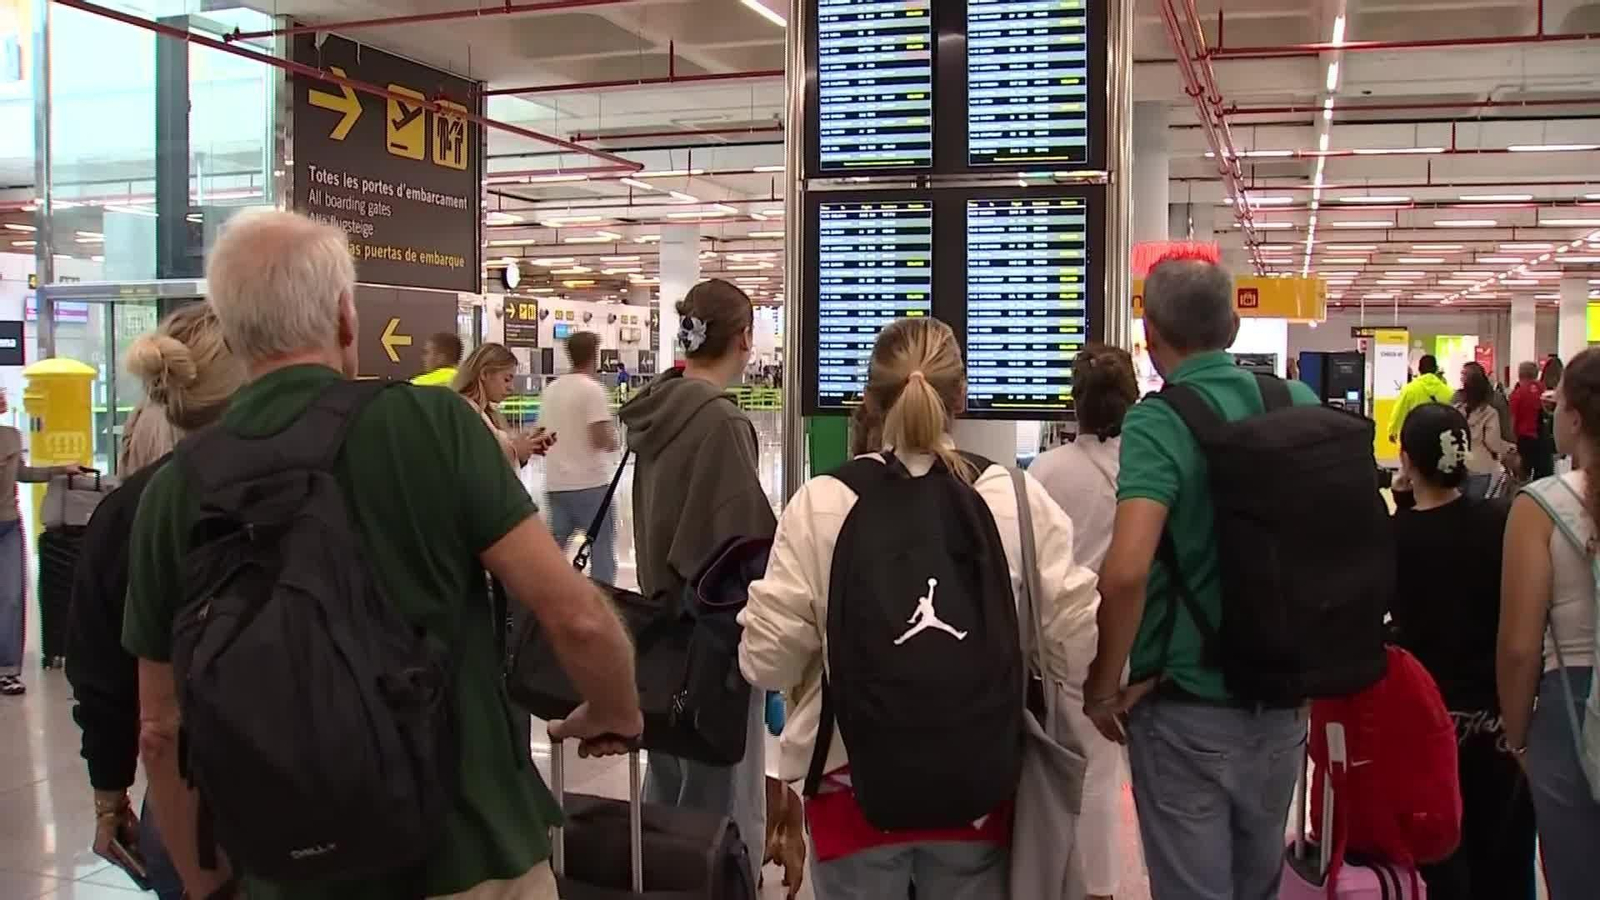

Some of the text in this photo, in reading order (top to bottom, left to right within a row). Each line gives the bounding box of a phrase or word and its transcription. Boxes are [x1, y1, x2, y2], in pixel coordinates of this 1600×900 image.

[308, 165, 468, 210] Totes les portes d'embarcament
[308, 188, 392, 217] All boarding gates
[364, 245, 402, 262] puertas
[404, 248, 417, 263] de
[420, 251, 465, 270] embarque
